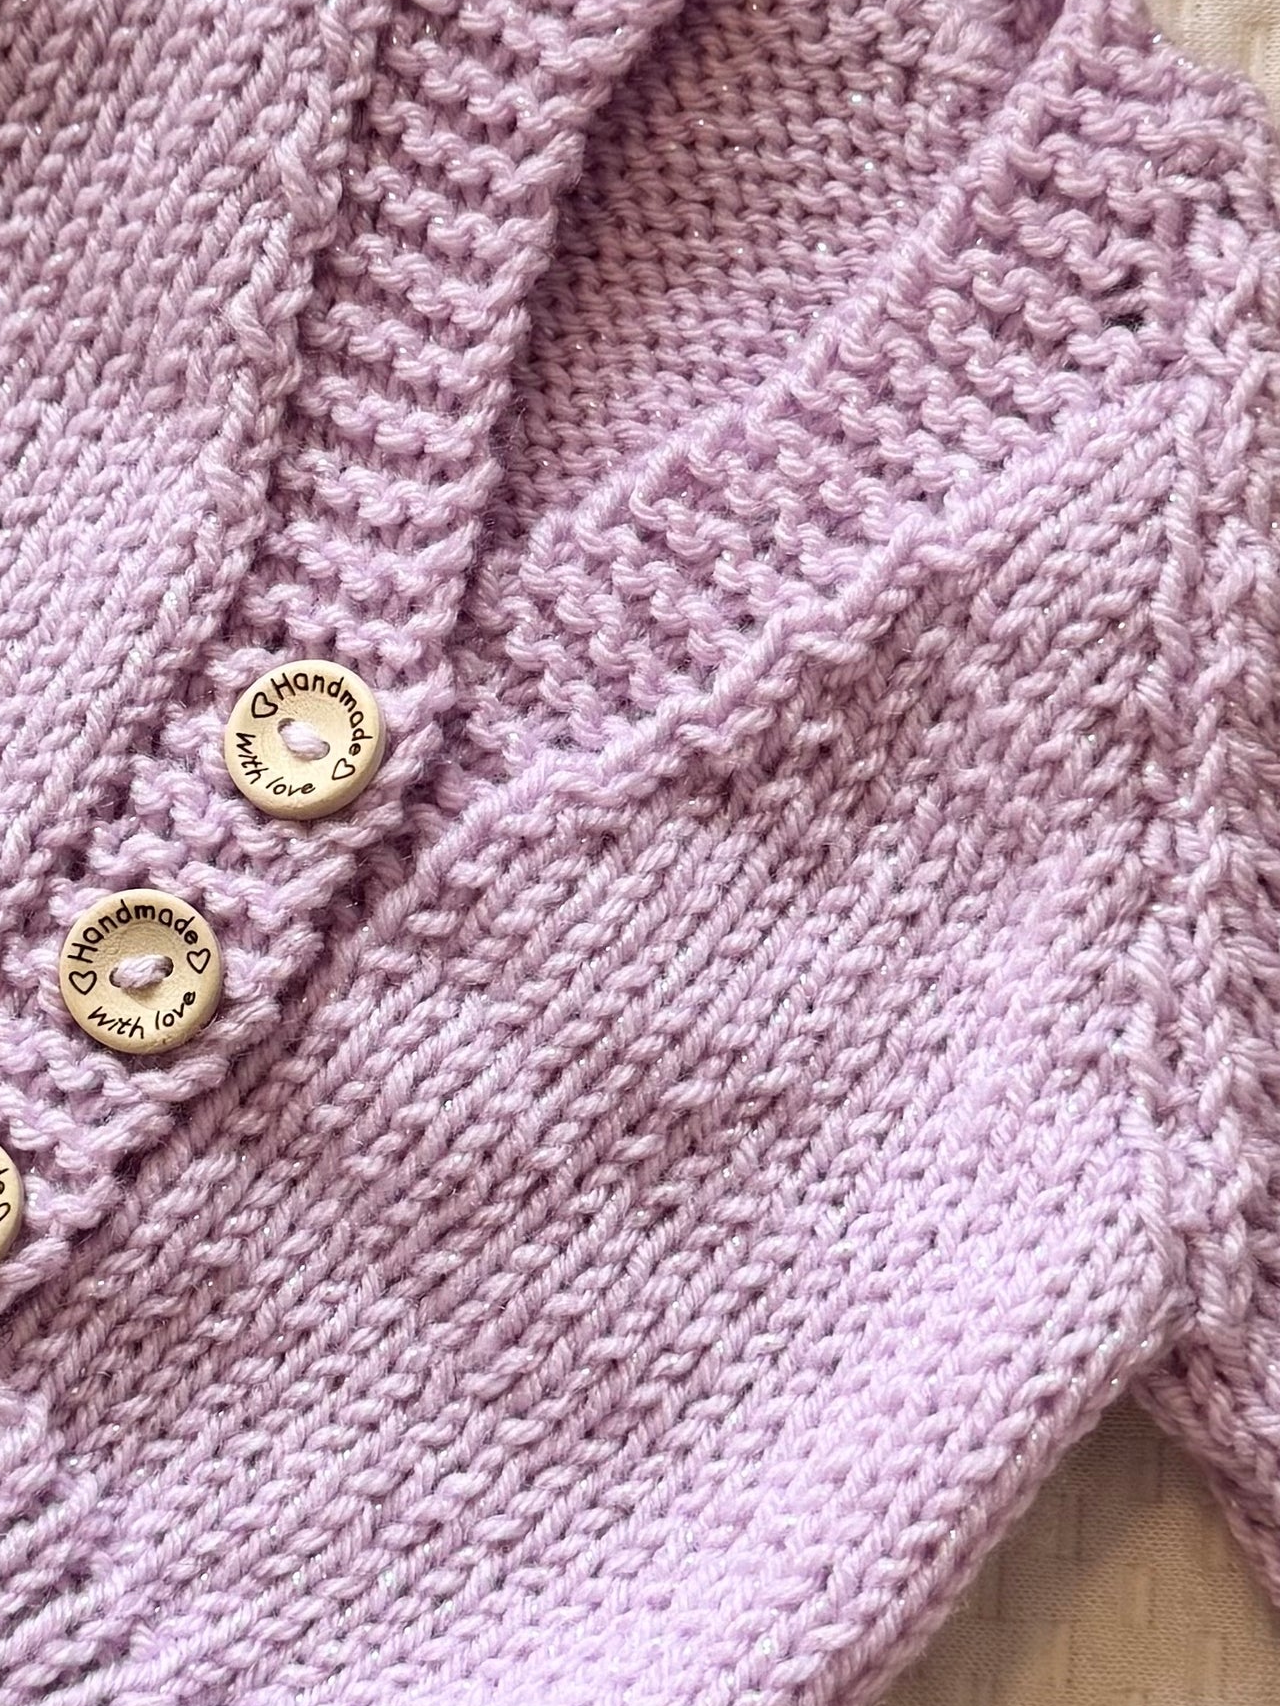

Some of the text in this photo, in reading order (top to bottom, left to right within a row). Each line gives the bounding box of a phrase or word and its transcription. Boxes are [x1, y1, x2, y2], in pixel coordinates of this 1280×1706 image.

[271, 673, 373, 756] Handmade
[266, 776, 316, 796] love
[67, 899, 198, 963] Handmade
[155, 991, 196, 1030] love
